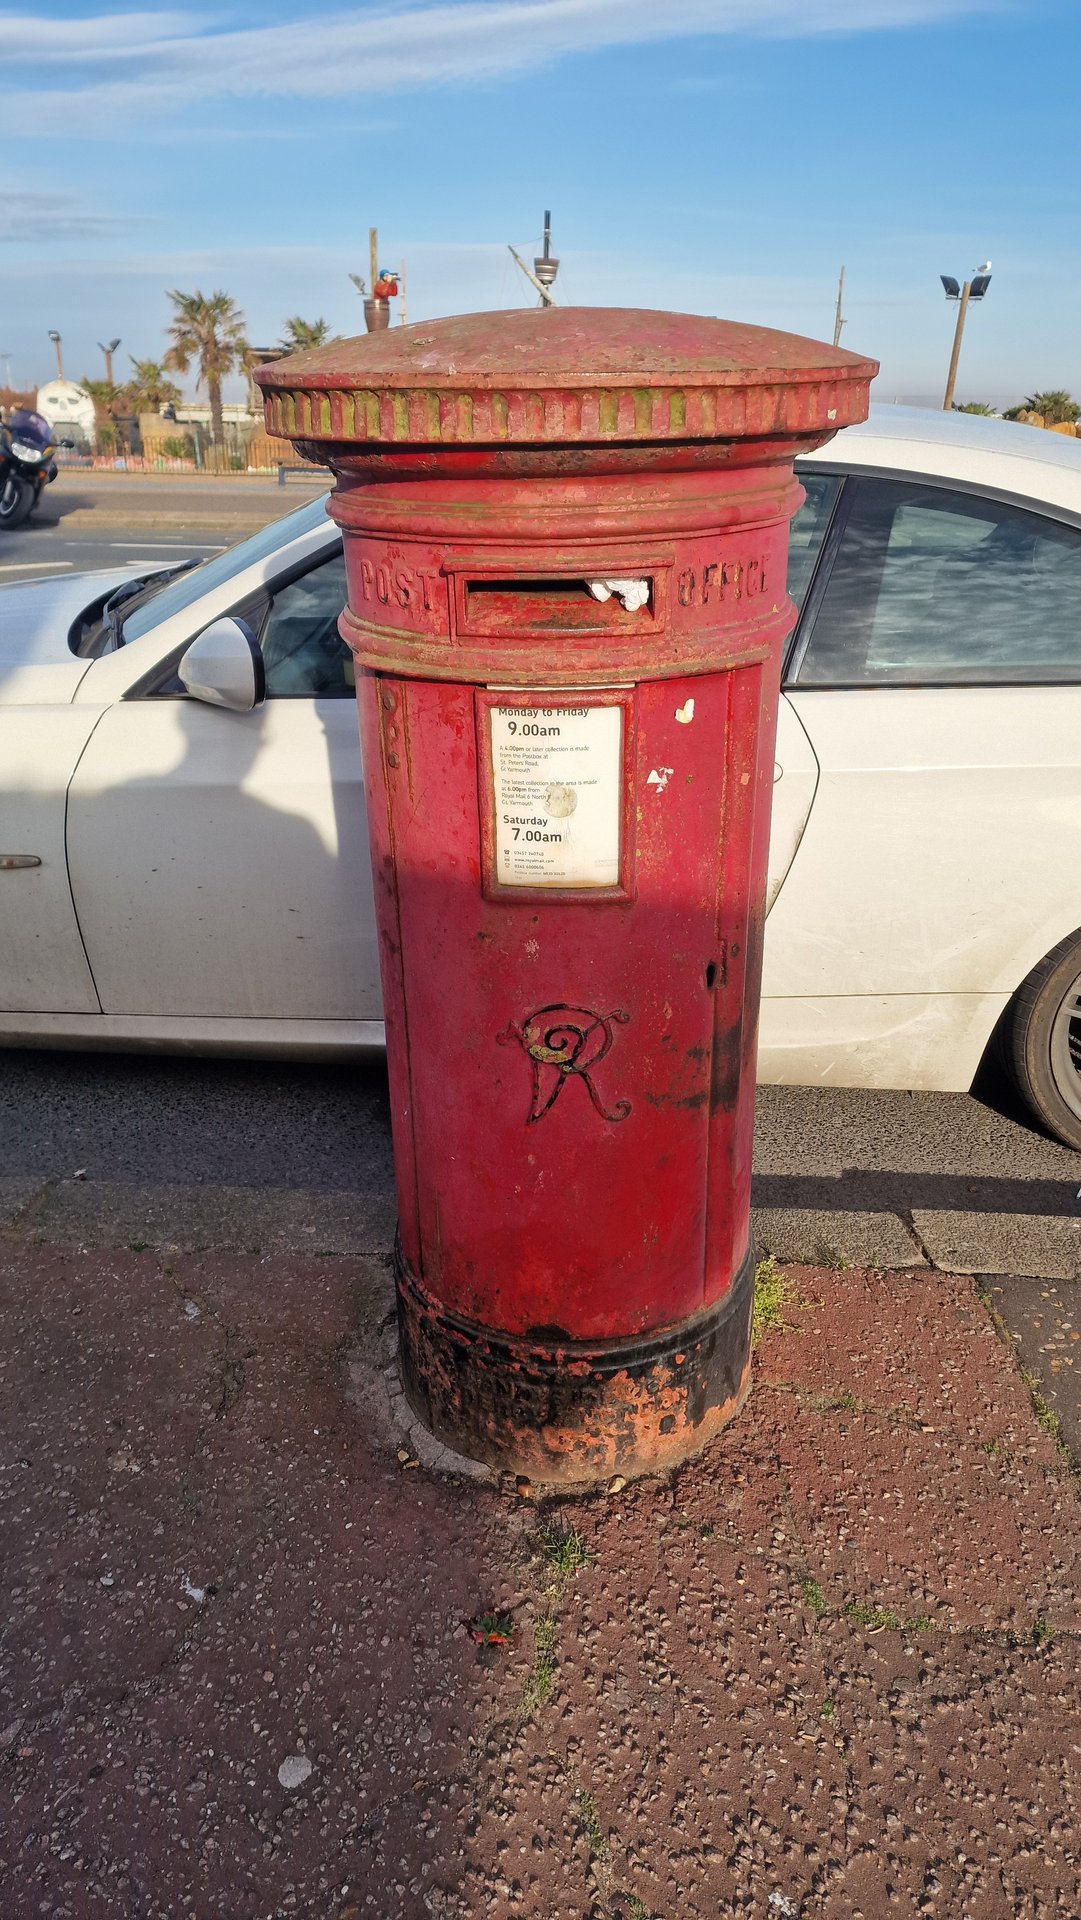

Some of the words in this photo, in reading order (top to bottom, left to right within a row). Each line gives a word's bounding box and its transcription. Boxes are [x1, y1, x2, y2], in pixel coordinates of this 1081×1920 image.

[361, 559, 437, 610] POST
[678, 556, 769, 607] OFFICE
[498, 708, 538, 718] Monday
[542, 709, 553, 717] to
[556, 708, 589, 717] Friday
[507, 721, 560, 736] 9.00am
[503, 814, 548, 828] Saturday
[511, 828, 562, 843] 7.00am
